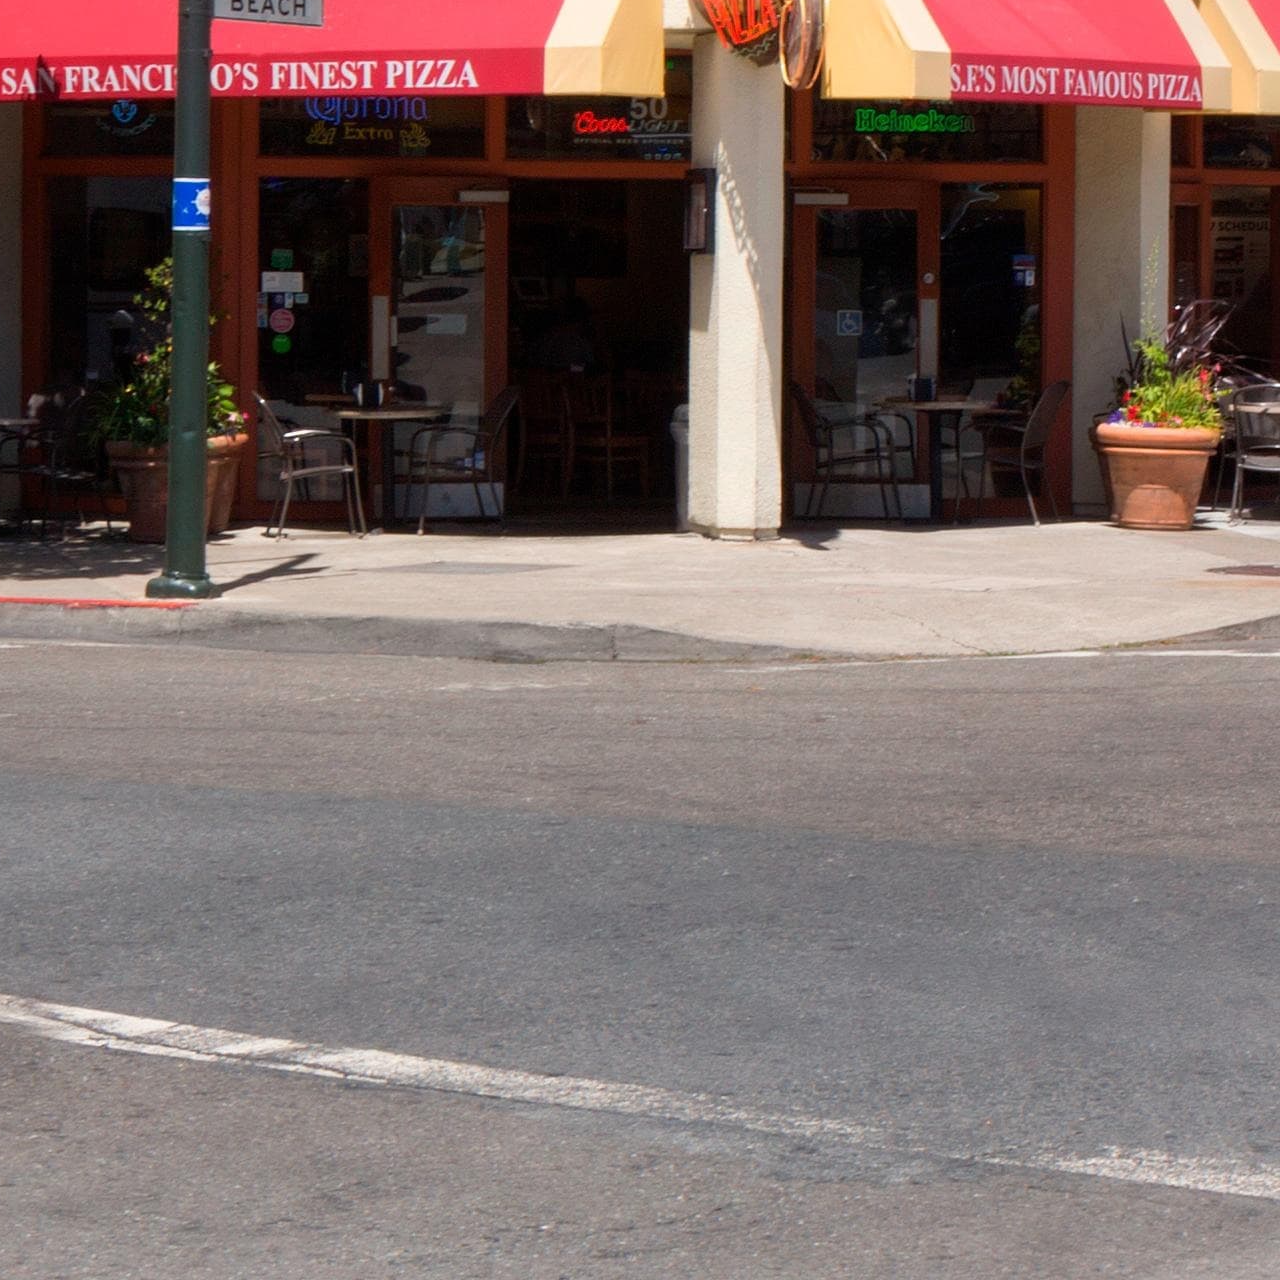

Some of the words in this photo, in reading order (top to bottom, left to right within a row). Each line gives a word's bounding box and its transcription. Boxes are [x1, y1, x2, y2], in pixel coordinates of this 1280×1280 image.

[1, 67, 57, 95] SAN
[63, 62, 259, 93] FRANCIO'S
[270, 61, 378, 90] FINEST
[384, 59, 479, 89] PIZZA
[1001, 66, 1061, 96] MOST
[1064, 68, 1144, 100] FAMOUS
[1147, 73, 1203, 102] PIZZA
[305, 96, 428, 125] Corona
[630, 97, 668, 120] 50
[854, 109, 975, 133] Heineken
[344, 124, 394, 140] Extra
